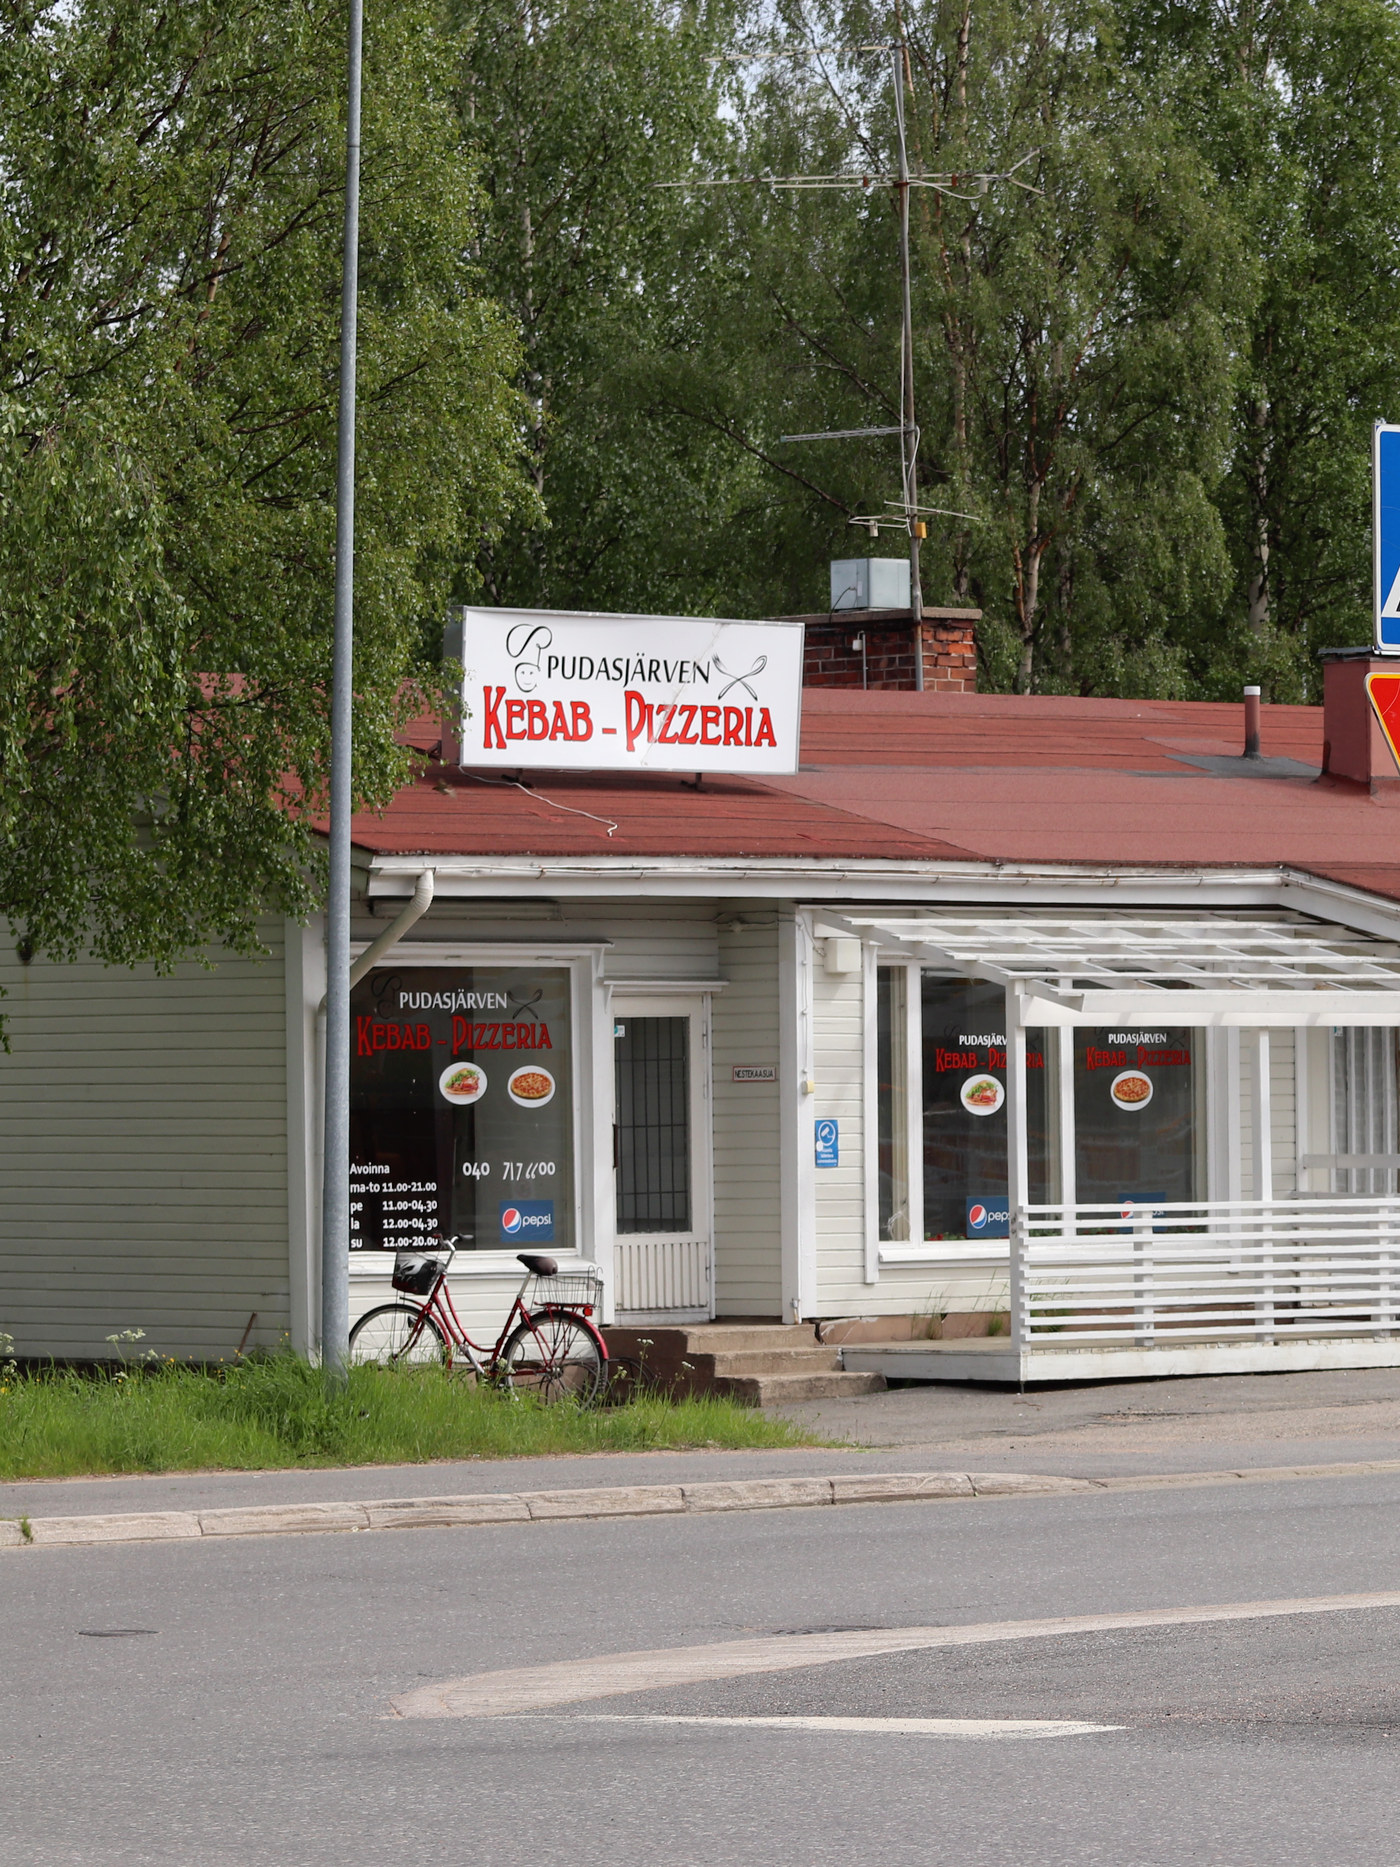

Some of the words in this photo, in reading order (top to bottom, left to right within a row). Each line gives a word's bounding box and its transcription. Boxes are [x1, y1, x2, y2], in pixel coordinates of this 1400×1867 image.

[547, 653, 710, 688] PUDASJÄRVEN
[482, 685, 594, 750] KEBAB
[624, 690, 778, 752] PIZZERIA
[400, 989, 508, 1014] PUDASJÄRVEN
[356, 1015, 432, 1056] KEBAB
[451, 1015, 553, 1056] PIZZERIA
[959, 1033, 1008, 1048] PUDASJÄRV
[1108, 1031, 1167, 1046] PUDASJÄRVEN
[935, 1048, 978, 1072] KEBAB
[988, 1047, 1044, 1072] PIZRIA
[1086, 1046, 1126, 1070] KEBAB
[1137, 1046, 1191, 1069] PIZZERIA
[349, 1162, 390, 1175] Avoinna
[462, 1162, 490, 1181] 040
[350, 1181, 380, 1193] ma-to
[382, 1181, 437, 1193] 11.00-21.00
[350, 1201, 363, 1215] pe
[382, 1199, 438, 1213] 11.00-04.30
[350, 1217, 360, 1230] la
[382, 1217, 438, 1231] 12.00-04.30
[522, 1213, 552, 1227] pepsi
[350, 1238, 363, 1248] su
[383, 1236, 438, 1248] 12.00-20.00
